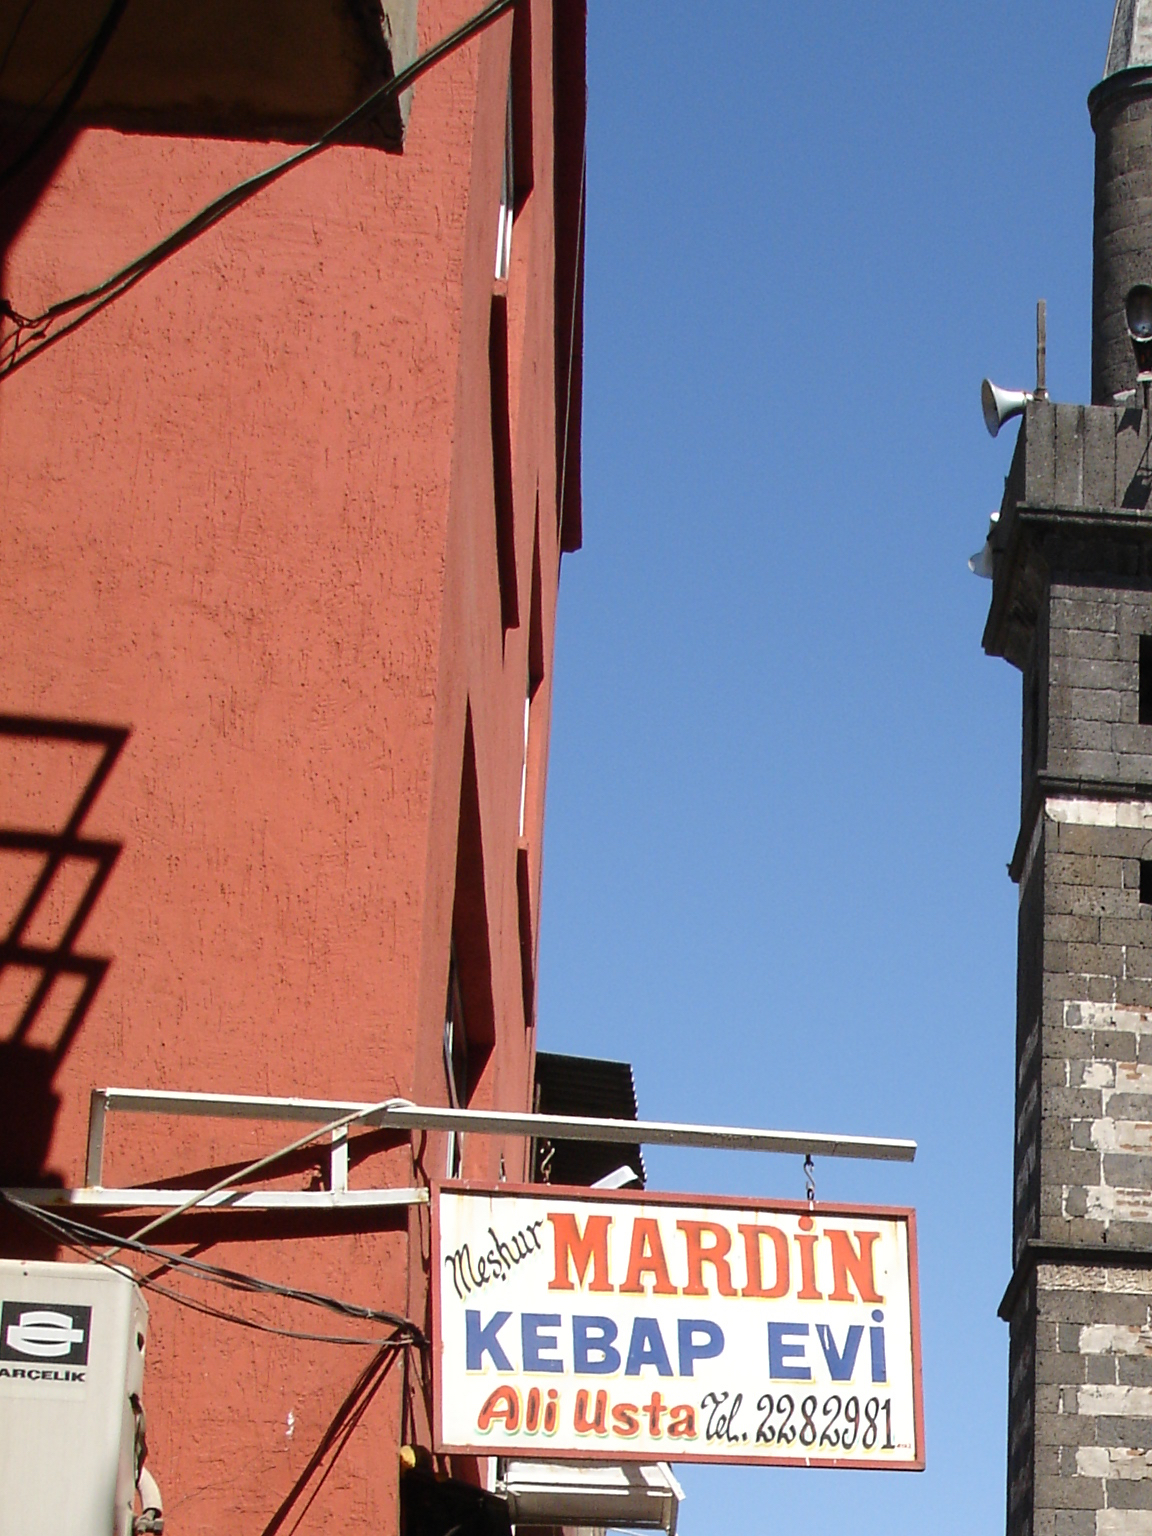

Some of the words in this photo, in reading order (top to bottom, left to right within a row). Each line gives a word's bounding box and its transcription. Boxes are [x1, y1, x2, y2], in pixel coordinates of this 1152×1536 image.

[444, 1219, 544, 1300] Meşhur
[547, 1213, 886, 1304] MARDİN
[0, 1368, 86, 1382] ARÇELİK
[466, 1310, 725, 1377] KEBAP
[767, 1309, 887, 1383] EVİ
[477, 1385, 558, 1432] Ali
[573, 1389, 698, 1438] Usta
[700, 1391, 748, 1442] Tel.
[755, 1394, 895, 1450] 2282981
